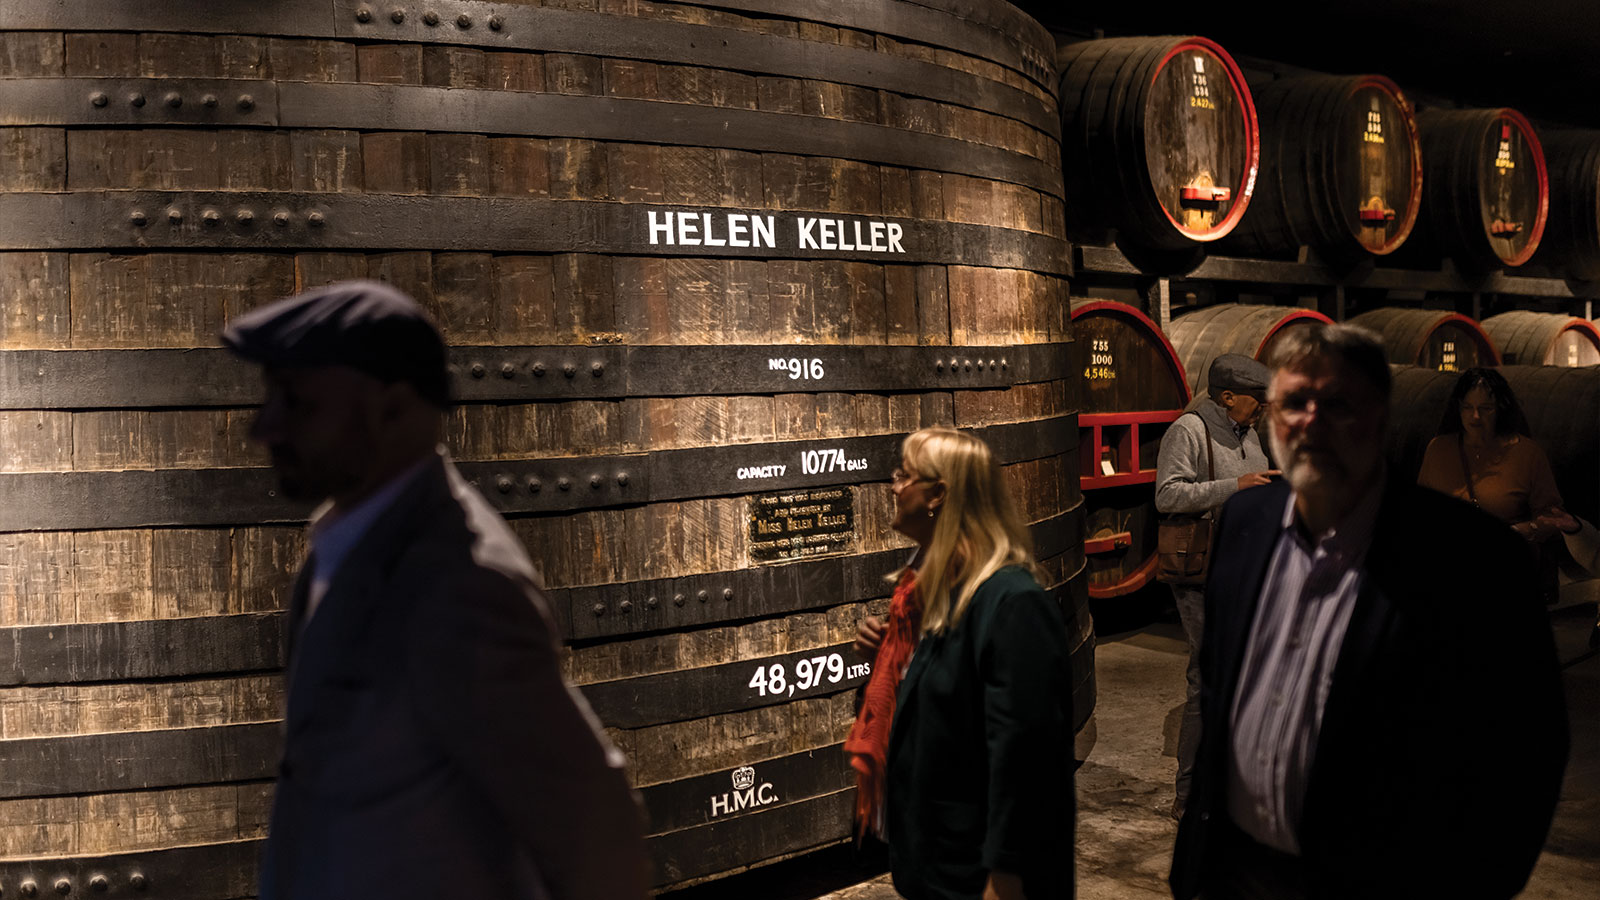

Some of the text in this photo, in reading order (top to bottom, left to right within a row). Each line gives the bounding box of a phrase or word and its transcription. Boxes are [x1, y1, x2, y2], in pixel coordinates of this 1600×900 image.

[647, 210, 906, 254] HELEN KELLER
[1092, 340, 1109, 352] 755
[788, 357, 825, 380] 916
[1084, 367, 1109, 380] 4,546
[1091, 354, 1113, 366] 1000
[736, 448, 868, 480] CAPACITY 10774 GALS
[748, 652, 871, 698] 48,979 LTRS
[710, 782, 780, 818] H.M.C.
